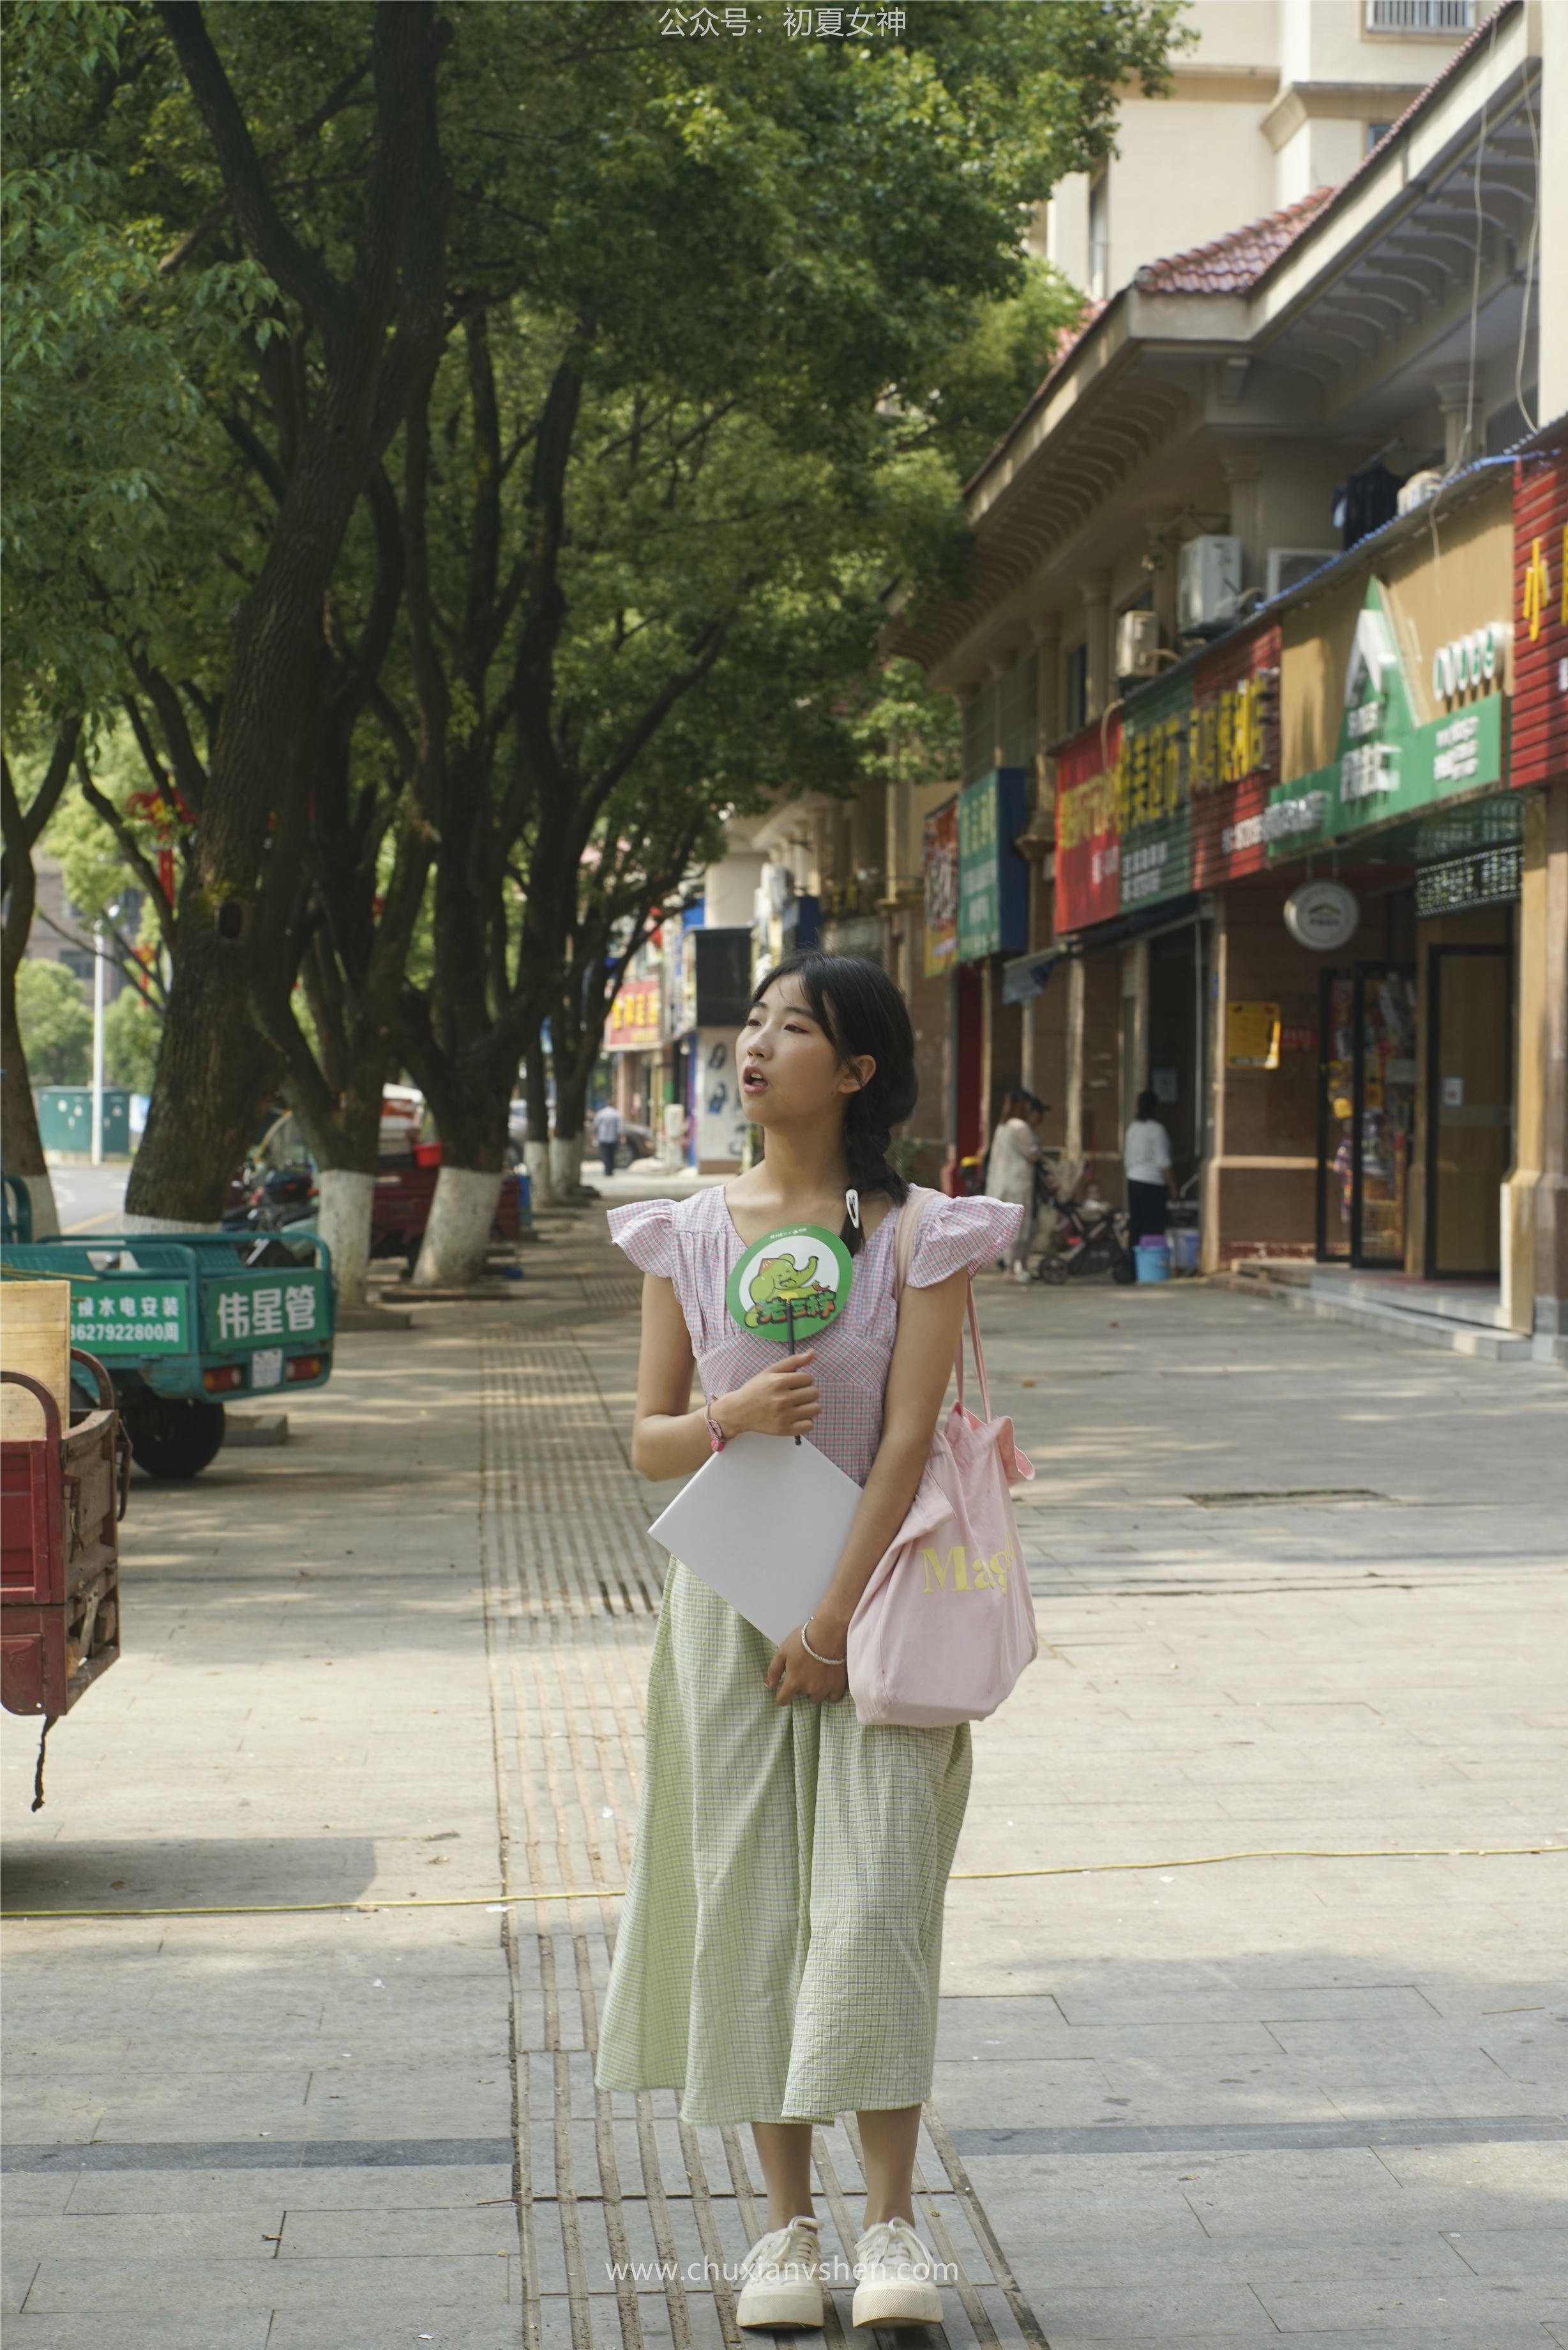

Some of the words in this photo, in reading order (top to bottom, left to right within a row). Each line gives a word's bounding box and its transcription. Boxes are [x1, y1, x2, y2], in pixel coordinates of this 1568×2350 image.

[71, 1296, 179, 1317] 接水电安装
[217, 1285, 316, 1338] 伟星管
[917, 1531, 1014, 1596] Mag
